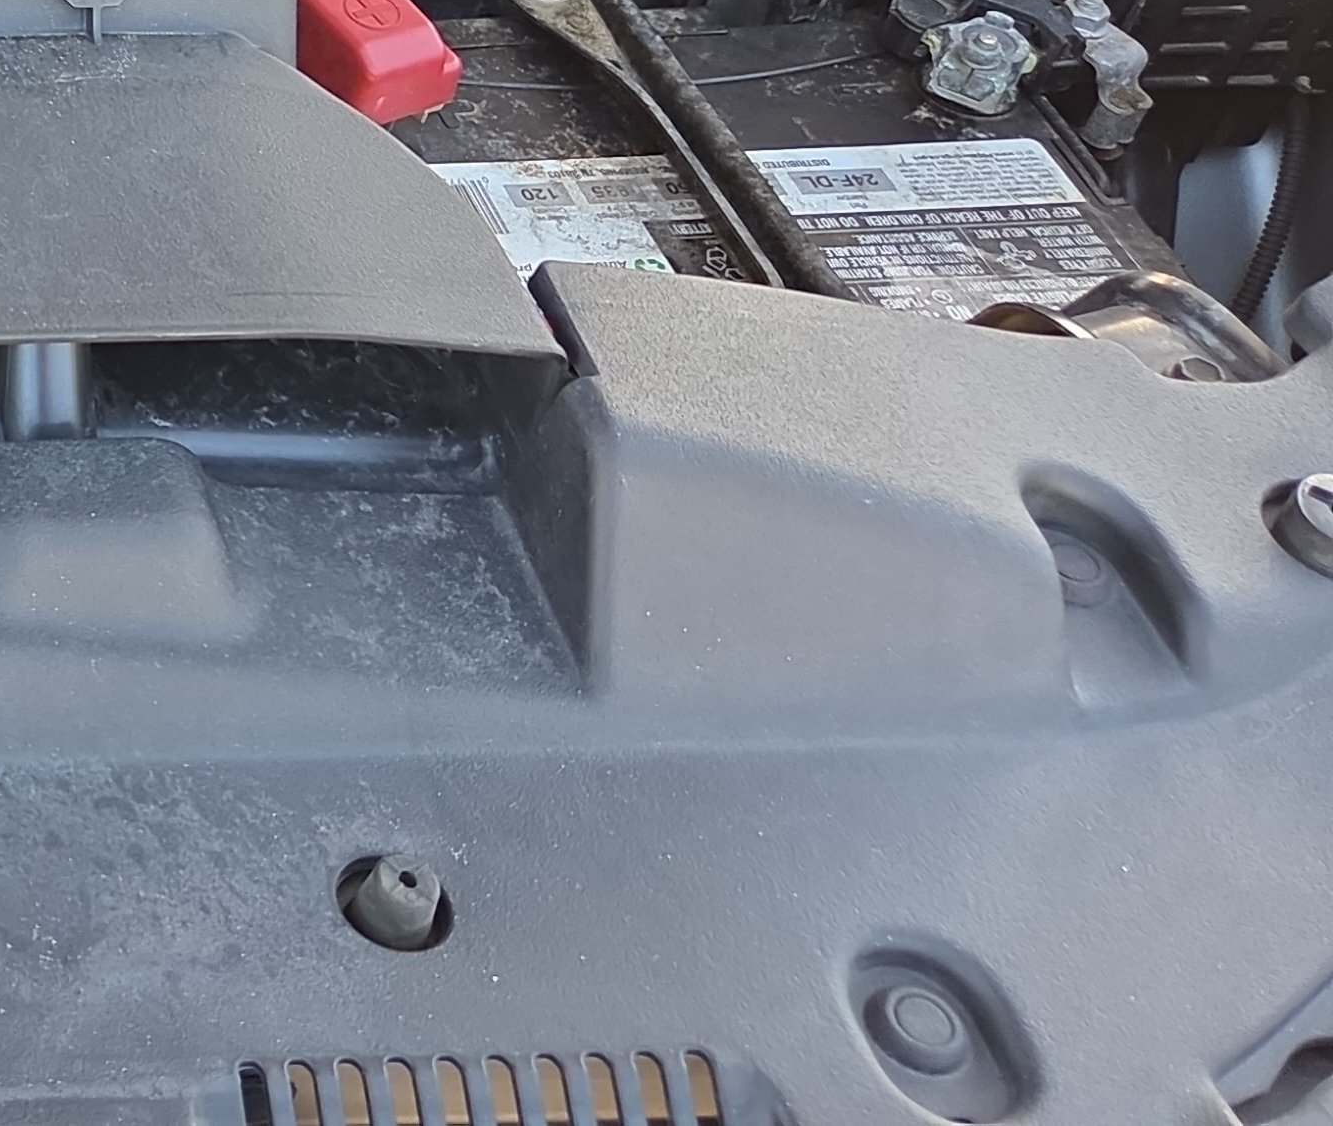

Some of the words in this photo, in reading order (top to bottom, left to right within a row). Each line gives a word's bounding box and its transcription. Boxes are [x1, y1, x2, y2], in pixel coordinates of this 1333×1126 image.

[763, 158, 831, 169] DISTRIBUTED
[799, 173, 879, 189] 24F-DL
[519, 187, 560, 202] 120
[941, 211, 983, 223] REACH
[982, 210, 1008, 221] THE
[1007, 209, 1025, 220] OF
[1025, 208, 1051, 219] OUT
[1052, 206, 1082, 218] KEEP
[838, 217, 860, 227] DO
[922, 213, 941, 224] OF
